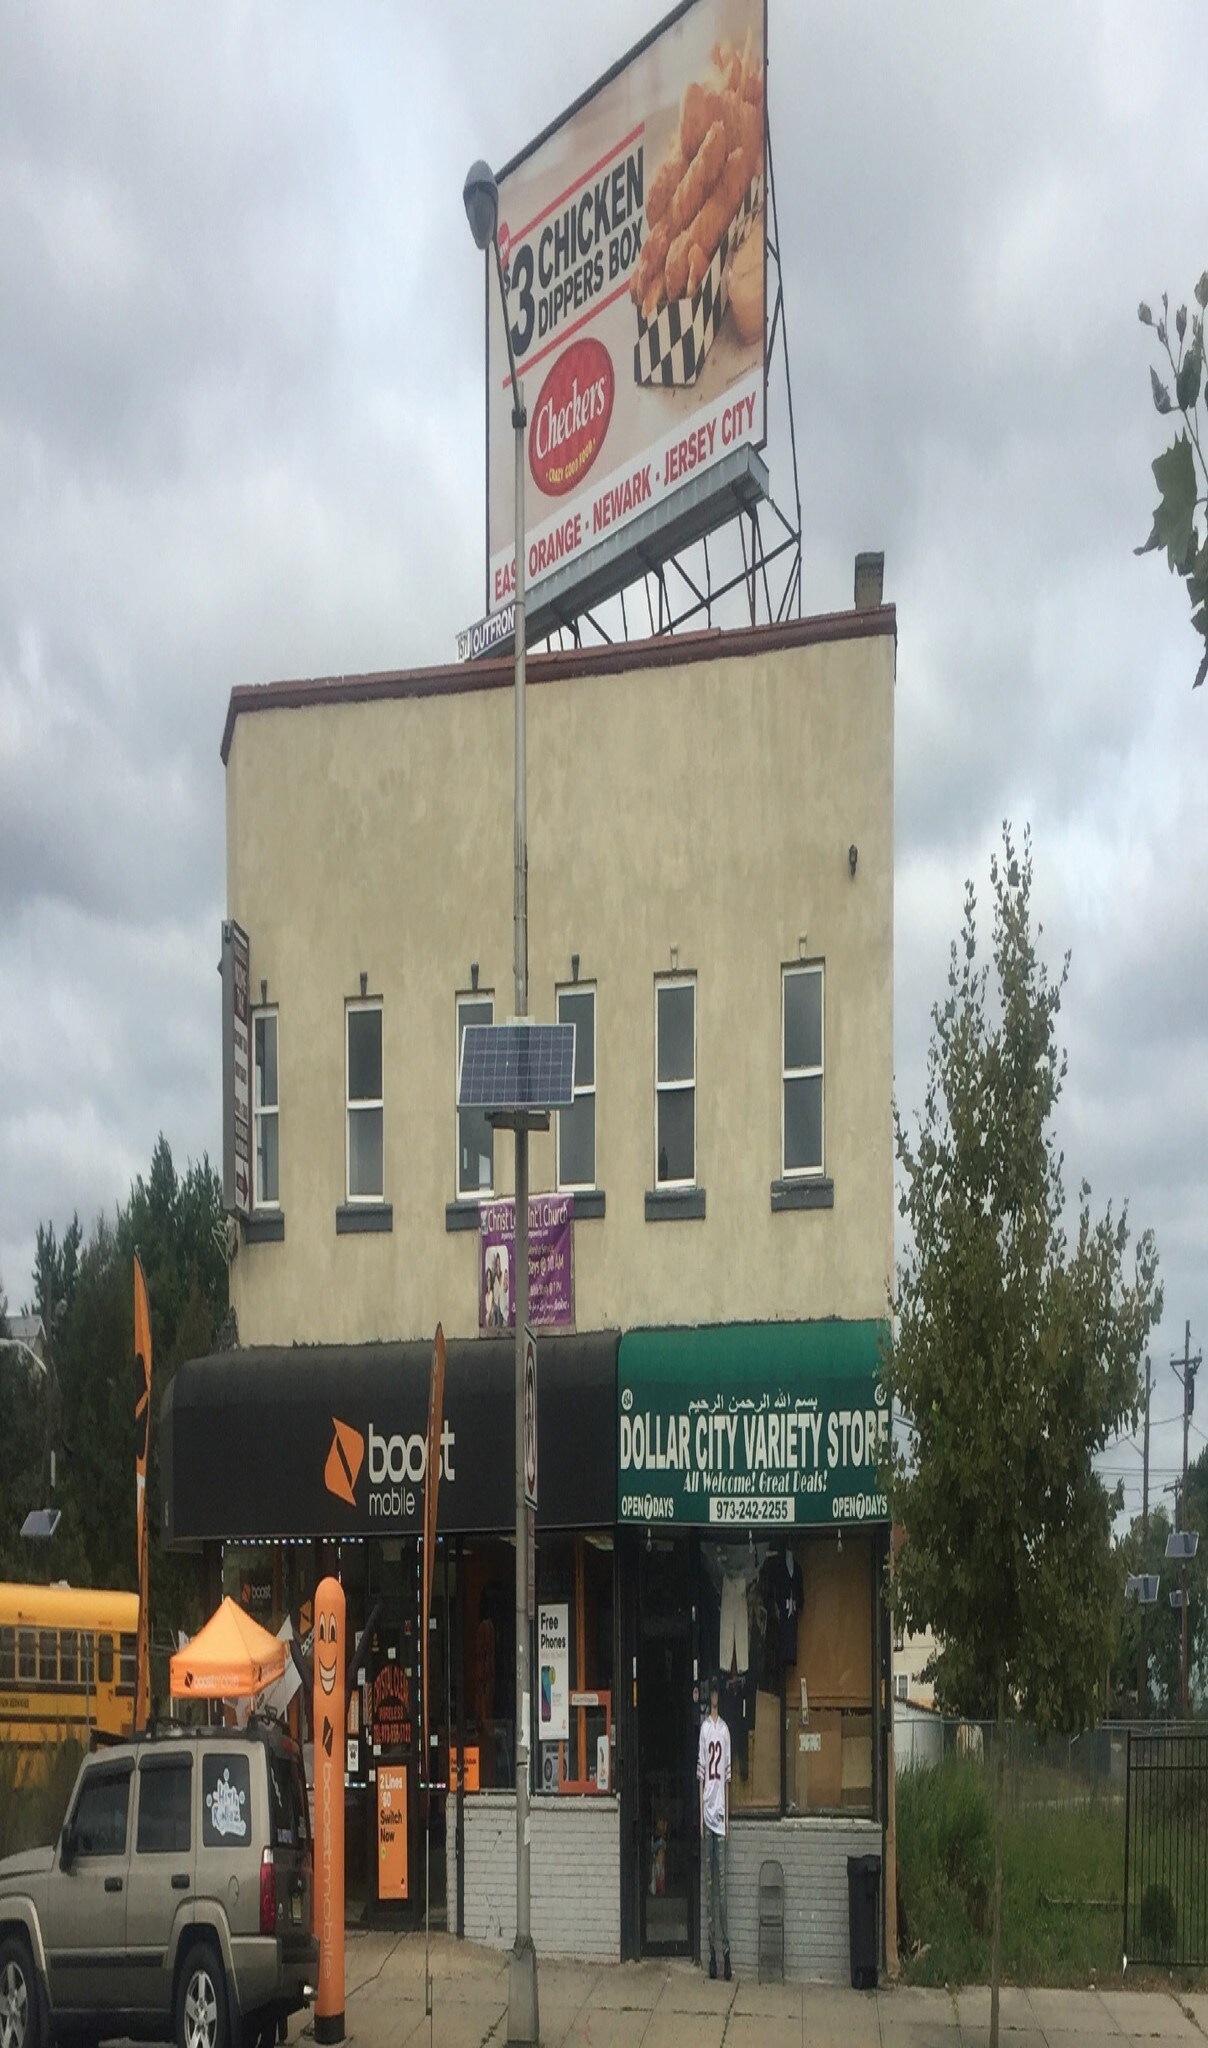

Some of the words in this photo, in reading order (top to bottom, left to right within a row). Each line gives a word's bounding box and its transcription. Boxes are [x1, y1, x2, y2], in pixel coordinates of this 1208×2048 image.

[538, 144, 644, 289] CHICKEN
[538, 249, 604, 339] DIPPERS
[608, 214, 643, 282] BOX
[534, 377, 606, 461] Checkers
[494, 556, 516, 602] EAS
[528, 513, 582, 578] ORANGE
[592, 463, 653, 535] NEWARK
[663, 417, 717, 486] JERSEY
[721, 391, 757, 446] CITY
[472, 604, 516, 653] OUTFRON
[488, 1207, 509, 1232] Christ
[543, 1201, 568, 1227] Church
[620, 1412, 691, 1470] DOLLAR
[695, 1413, 738, 1470] CITY
[743, 1412, 823, 1470] VARIETY
[683, 1470, 699, 1493] All
[702, 1469, 756, 1494] Welcome!
[759, 1470, 790, 1493] Great
[793, 1469, 828, 1493] Deals!
[369, 1487, 416, 1517] mobile
[621, 1495, 644, 1517] OPEN
[653, 1497, 674, 1518] DAYS
[716, 1501, 788, 1520] 973-242-2255
[832, 1496, 856, 1518] OPEN
[865, 1495, 888, 1516] DAYS
[252, 1584, 272, 1600] boost
[540, 1612, 559, 1631] Free
[540, 1634, 566, 1649] Phones
[708, 1740, 722, 1781] 22
[379, 1773, 385, 1790] 2
[385, 1773, 403, 1790] Lines
[380, 1809, 403, 1825] Switch
[380, 1826, 395, 1843] Now
